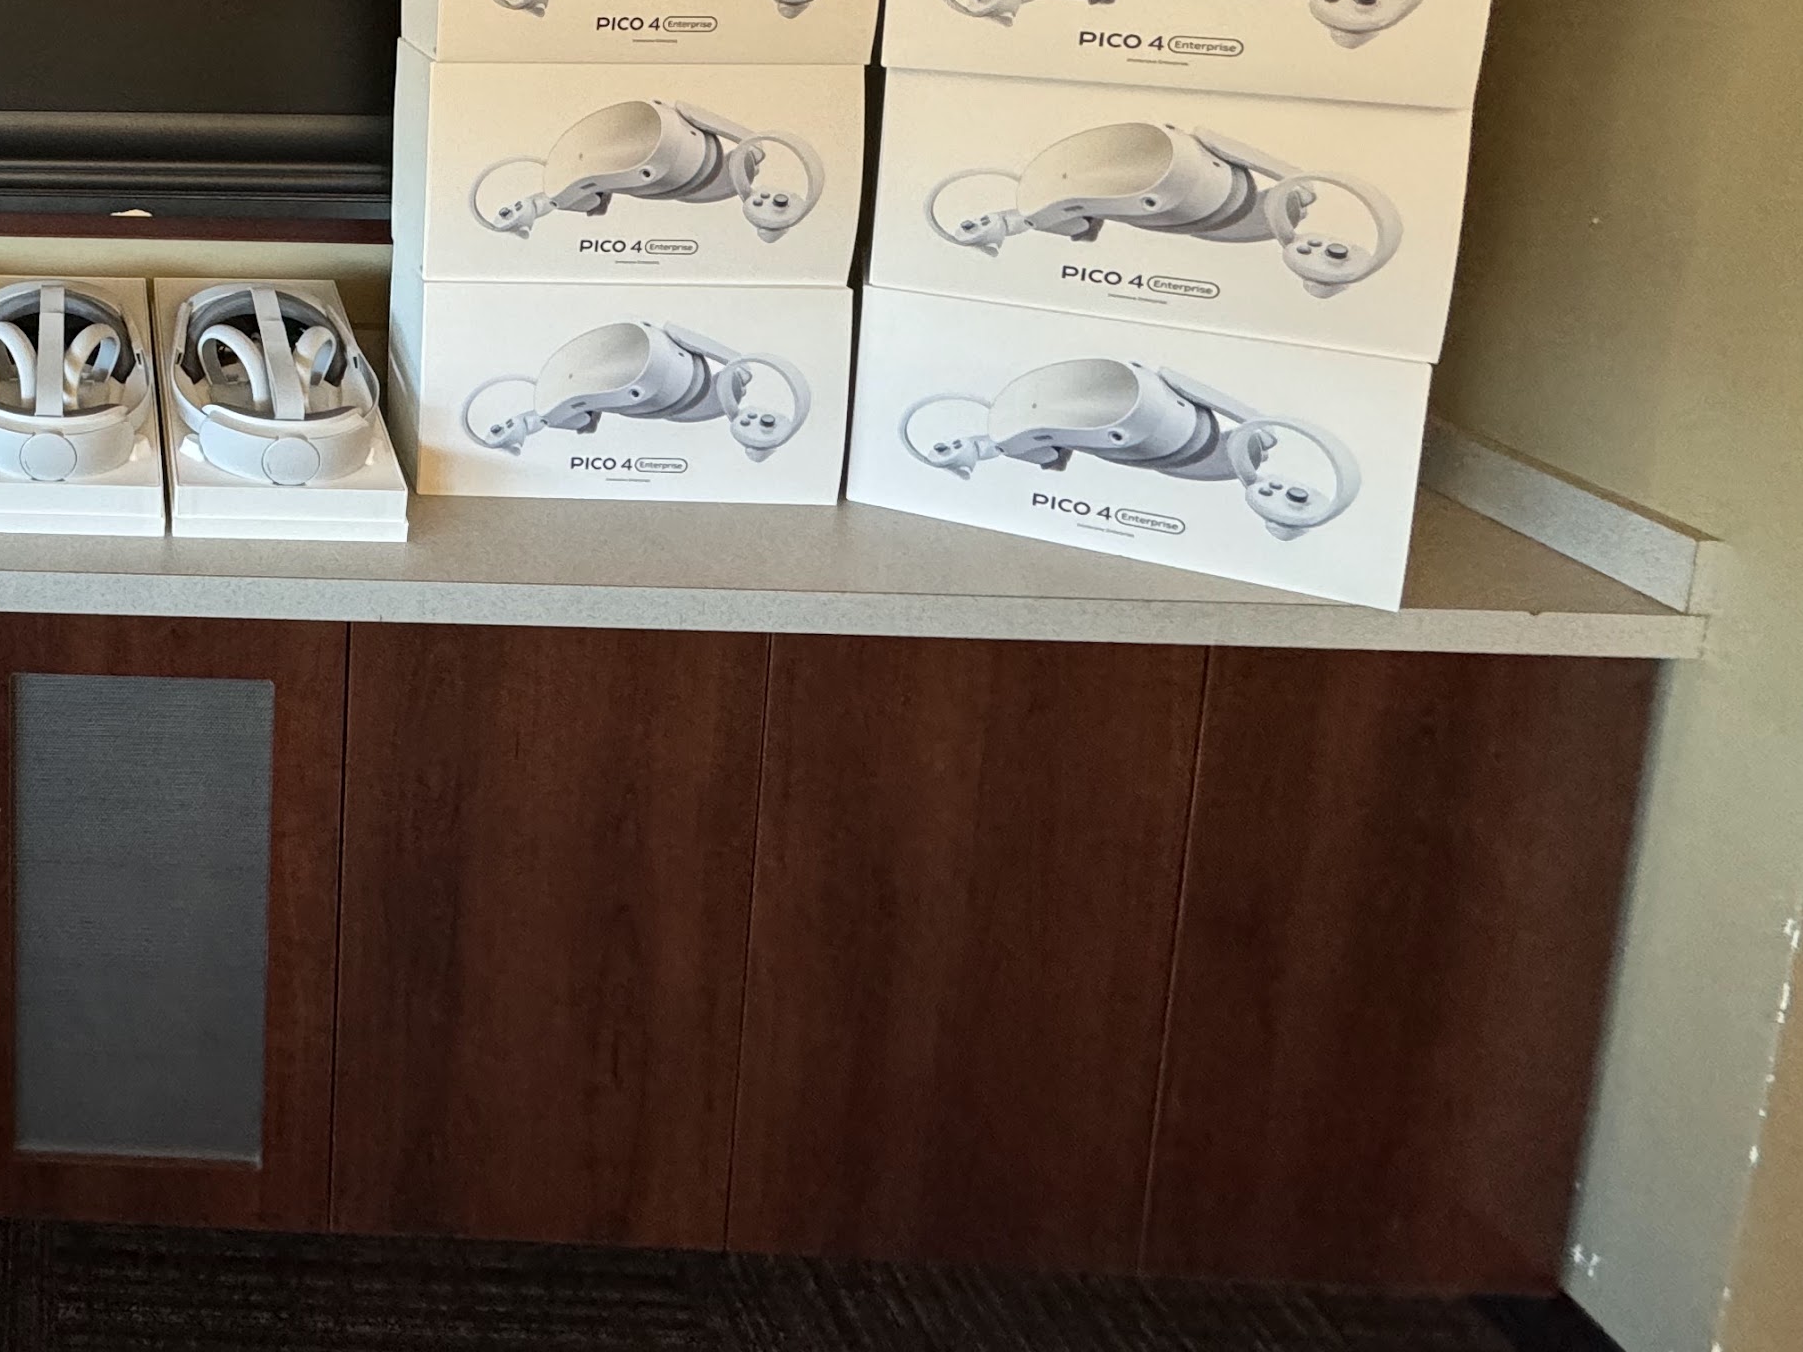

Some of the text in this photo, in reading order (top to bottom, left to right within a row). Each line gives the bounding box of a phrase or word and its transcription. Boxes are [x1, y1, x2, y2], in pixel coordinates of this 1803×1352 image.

[596, 16, 713, 31] PICO 4 Enterprise
[1078, 31, 1237, 53] PICO 4 Enterprise
[579, 239, 694, 254] PICO 4 Enterprise
[1061, 265, 1213, 295] PICO 4 Enterprise
[570, 457, 683, 471] PICO 4 Enterprise
[1032, 492, 1091, 516] PICO
[1096, 506, 1112, 521] 4
[1121, 512, 1179, 531] Enterprise
